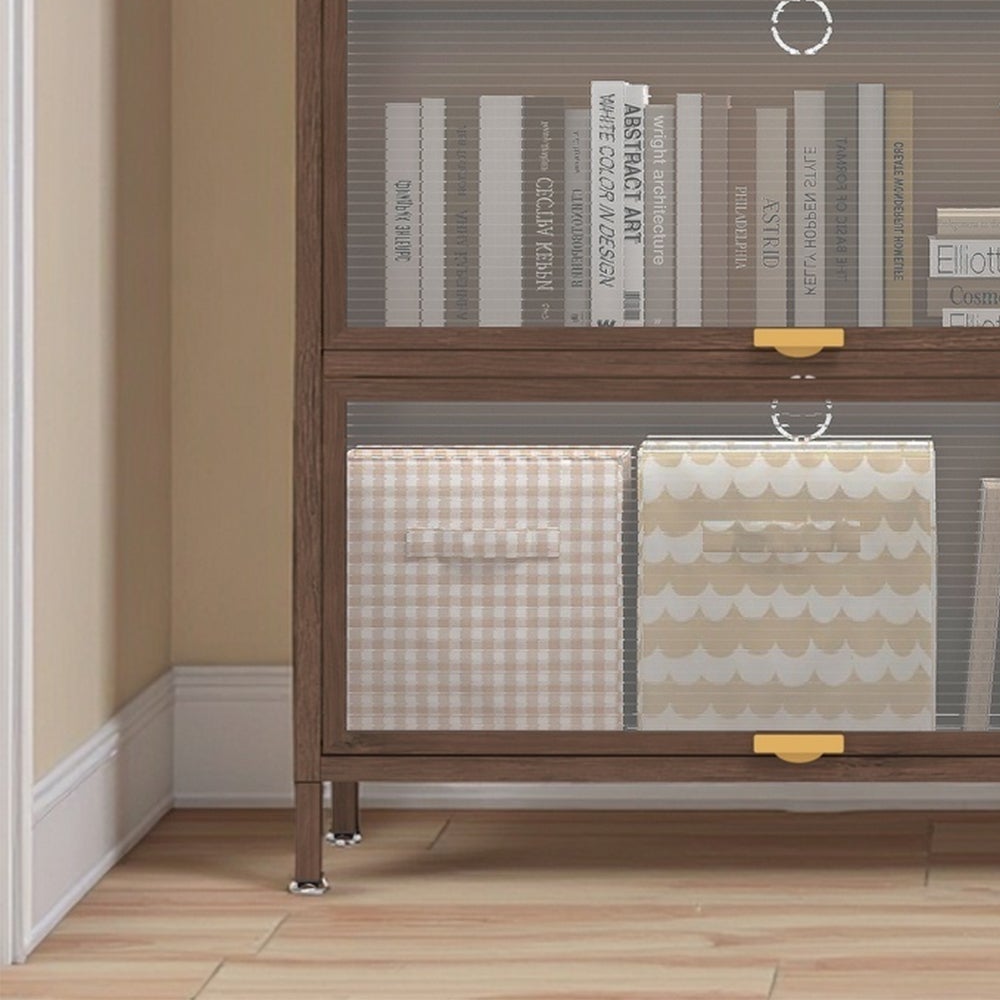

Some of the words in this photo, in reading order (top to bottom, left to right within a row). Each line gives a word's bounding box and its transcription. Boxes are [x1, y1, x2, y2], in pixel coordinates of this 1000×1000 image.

[599, 93, 616, 144] WHITE
[651, 115, 665, 165] wright
[599, 146, 616, 203] COLOR
[624, 102, 643, 202] ABSTRACT
[599, 206, 616, 222] IN
[624, 206, 643, 244] ART
[652, 171, 665, 267] architecture
[599, 222, 616, 288] DESIGN
